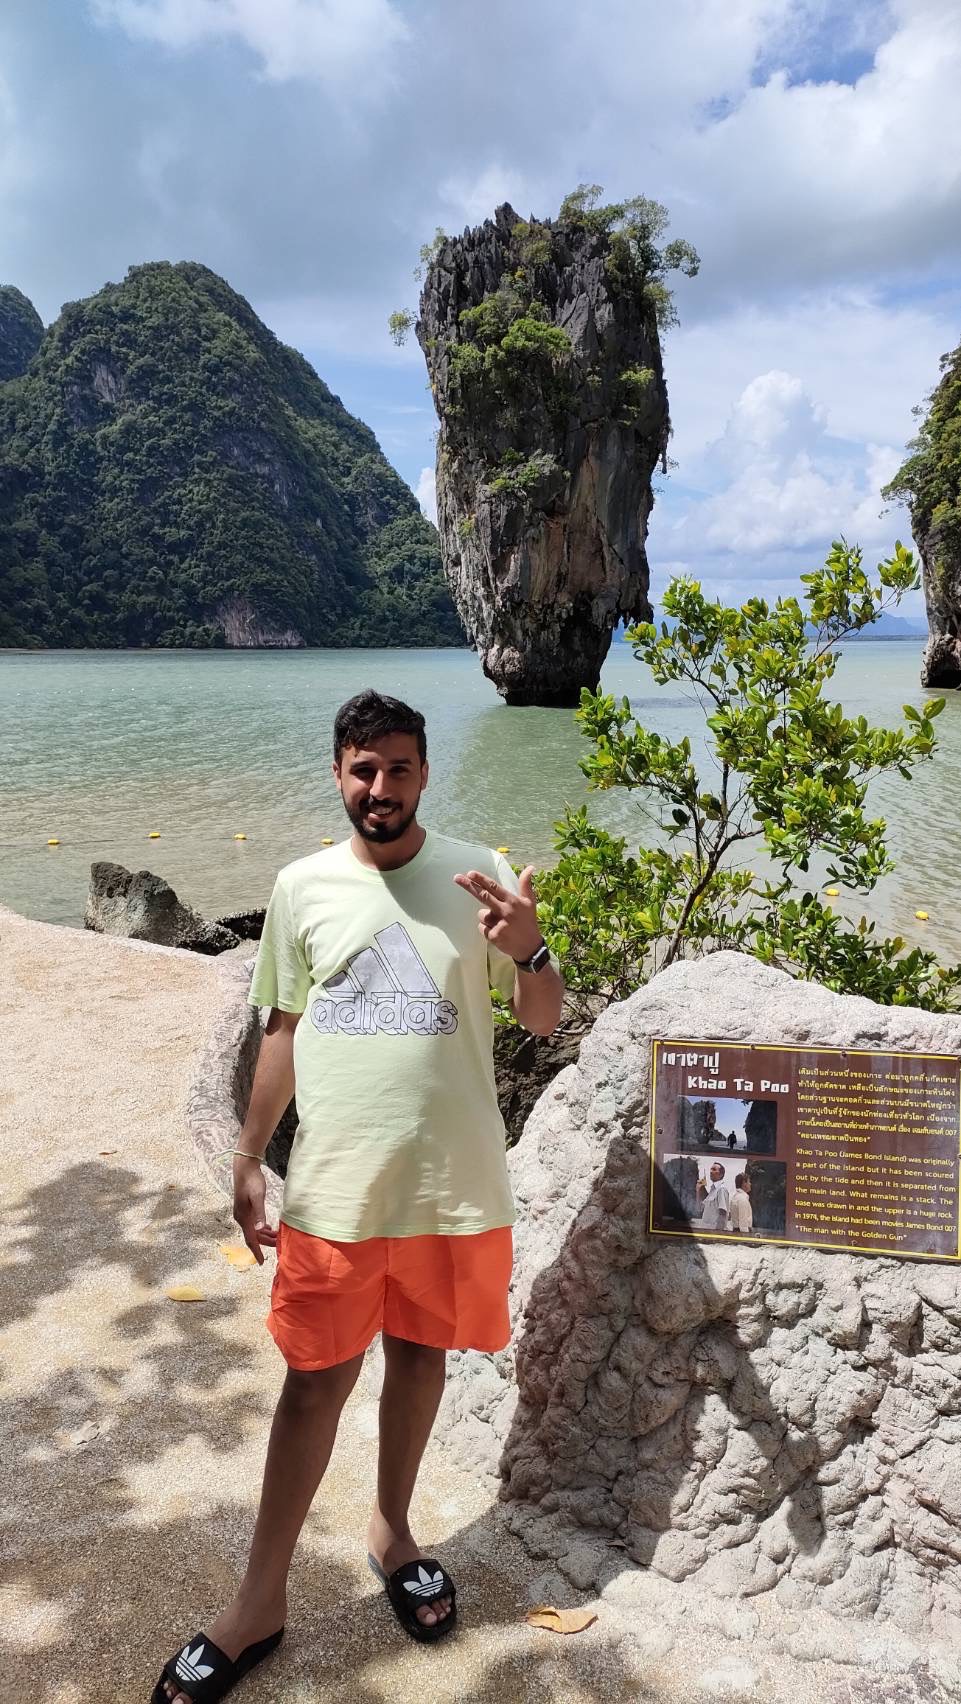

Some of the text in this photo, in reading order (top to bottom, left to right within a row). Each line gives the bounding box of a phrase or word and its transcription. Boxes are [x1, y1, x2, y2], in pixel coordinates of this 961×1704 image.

[310, 992, 458, 1035] adidas
[662, 1052, 719, 1074] เขาตาปู
[687, 1075, 789, 1093] Khao Ta Poo
[796, 1148, 813, 1156] Khao
[839, 1150, 862, 1159] (James
[864, 1152, 882, 1160] Bond
[923, 1157, 955, 1167] originally
[843, 1164, 864, 1172] island
[904, 1169, 922, 1177] been
[925, 1171, 954, 1179] scoured
[821, 1175, 832, 1183] the
[835, 1176, 849, 1184] tide
[867, 1179, 883, 1187] then
[900, 1182, 937, 1191] separated
[939, 1184, 956, 1192] from
[809, 1187, 827, 1195] main
[829, 1188, 847, 1197] land.
[849, 1190, 868, 1198] What
[870, 1193, 899, 1201] remains
[916, 1196, 937, 1204] stack.
[939, 1197, 954, 1205] The
[795, 1199, 811, 1207] base
[826, 1201, 847, 1210] drawn
[848, 1203, 855, 1211] in
[856, 1204, 869, 1212] and
[871, 1205, 883, 1213] the
[884, 1207, 905, 1215] upper
[920, 1209, 936, 1218] huge
[795, 1224, 812, 1232] "The
[830, 1228, 846, 1236] with
[848, 1229, 860, 1237] the
[861, 1231, 887, 1239] Golden
[888, 1233, 908, 1241] Gun"
[851, 1216, 863, 1224] had
[864, 1218, 880, 1226] been
[881, 1220, 904, 1228] movies
[905, 1221, 925, 1230] James
[926, 1223, 943, 1231] Bond
